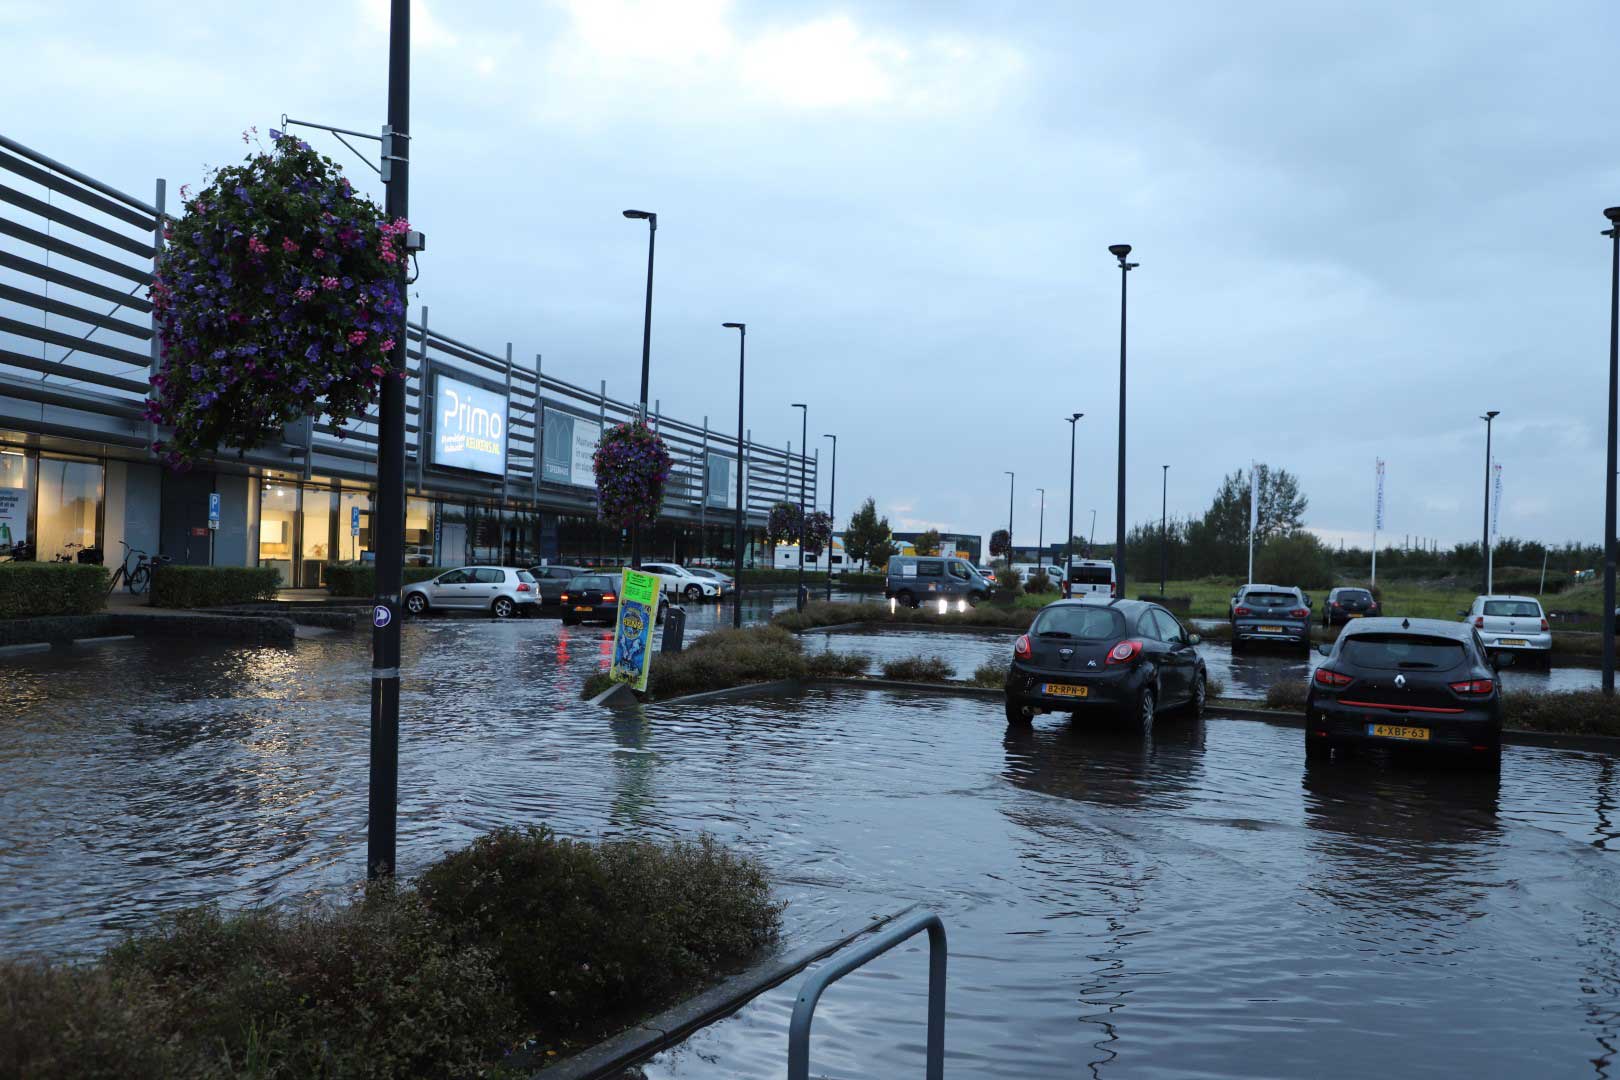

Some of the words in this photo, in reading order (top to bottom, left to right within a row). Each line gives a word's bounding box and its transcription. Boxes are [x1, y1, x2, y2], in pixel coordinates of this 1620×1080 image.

[443, 389, 502, 439] Primo
[1048, 685, 1086, 696] 82-RPN-9
[1376, 726, 1425, 738] 4-XBF-63
